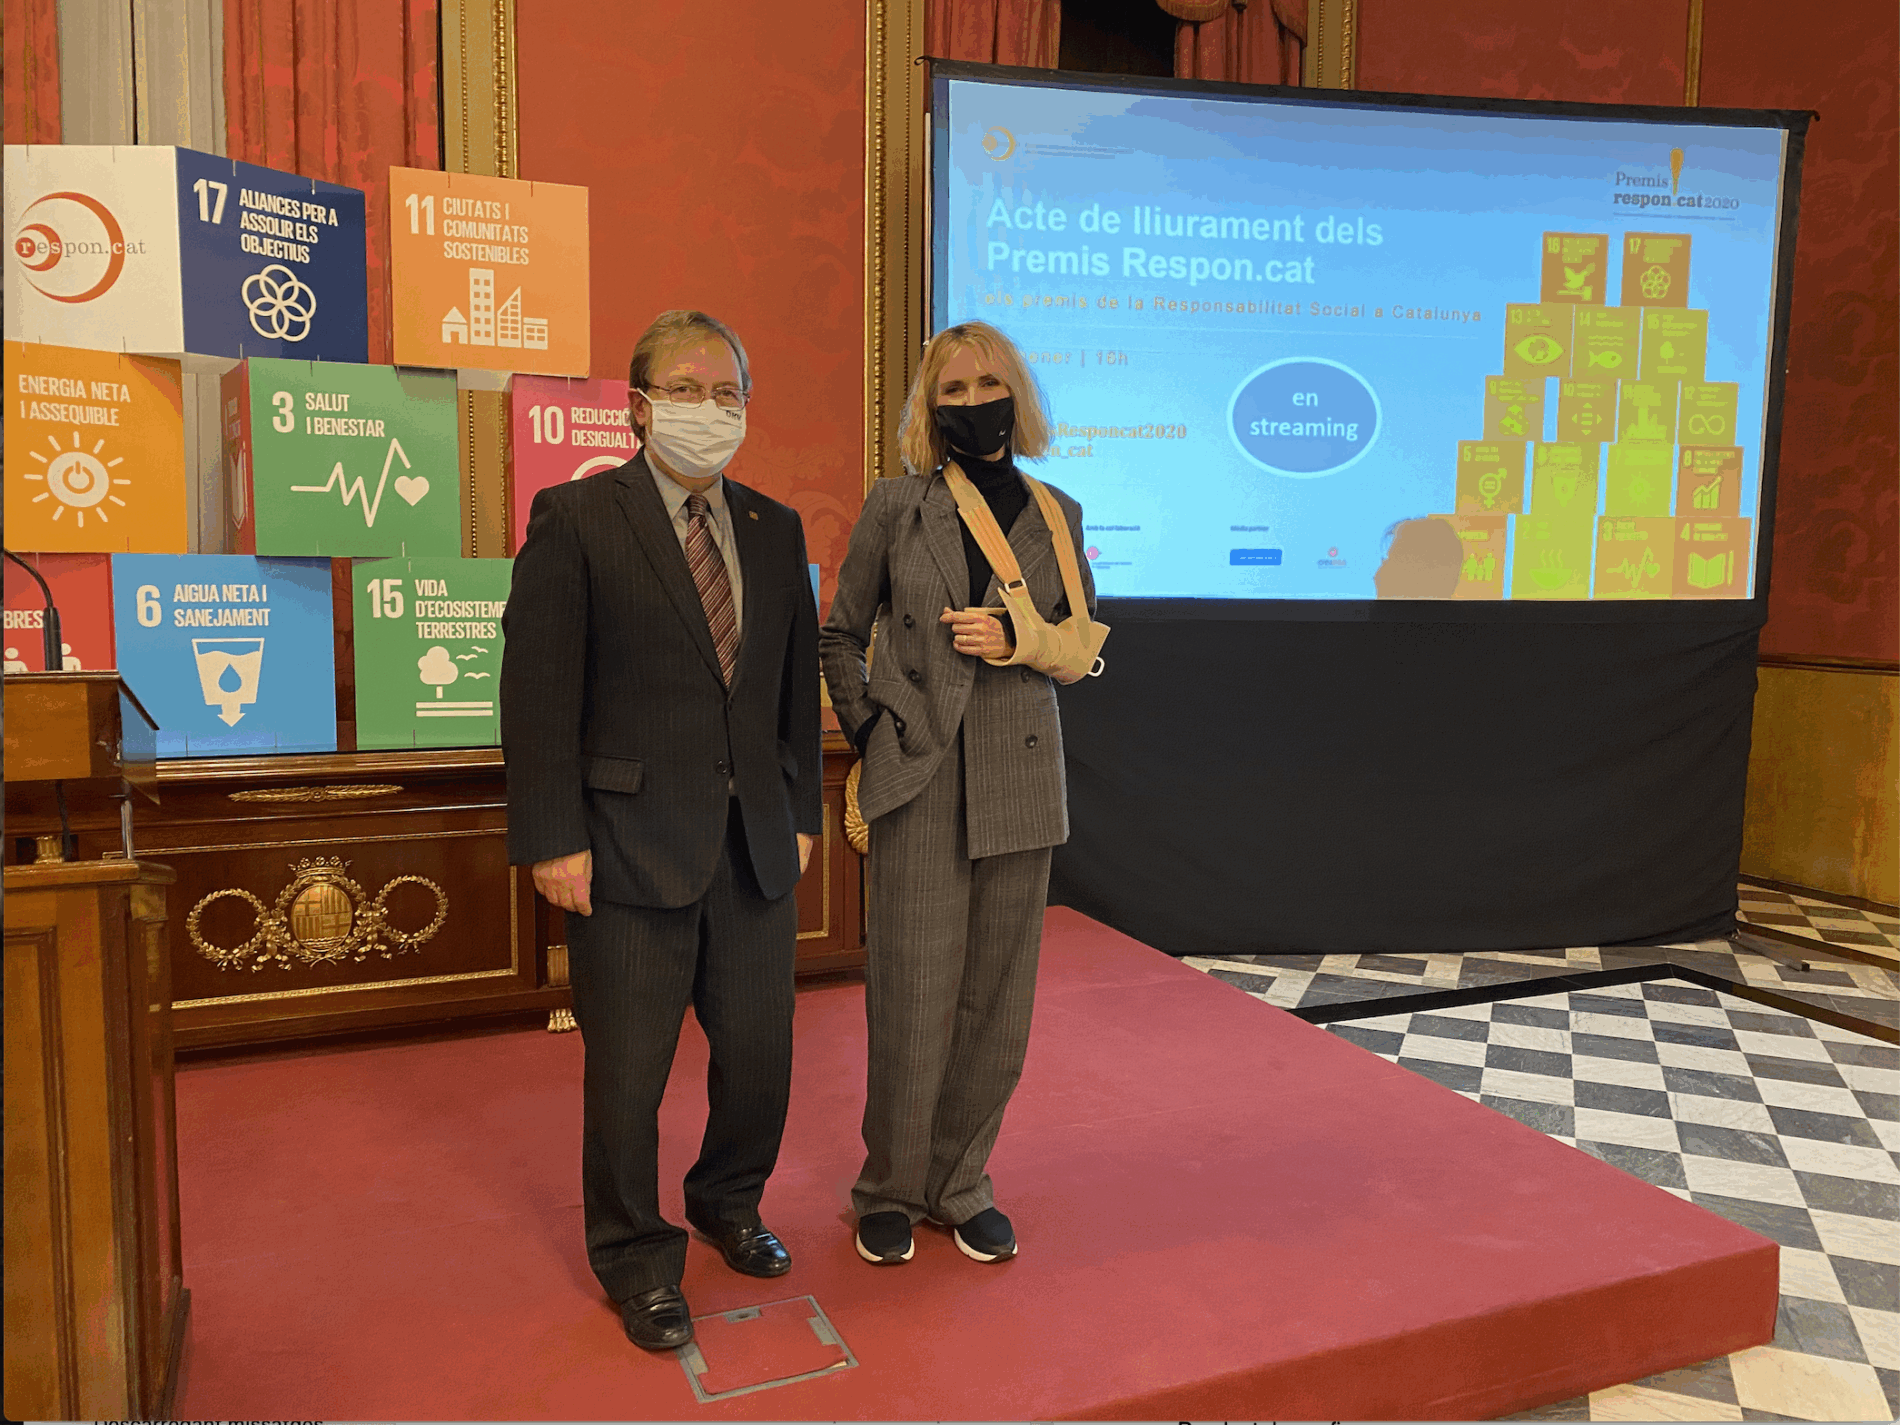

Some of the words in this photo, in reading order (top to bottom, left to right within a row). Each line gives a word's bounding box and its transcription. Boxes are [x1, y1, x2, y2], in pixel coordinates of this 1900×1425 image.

[1615, 171, 1669, 188] Premis
[192, 178, 228, 225] 17
[239, 188, 300, 219] ALIANCES
[302, 205, 325, 224] PER
[327, 208, 339, 227] A
[405, 193, 435, 236] 11
[443, 197, 501, 220] CIUTATS
[505, 203, 510, 220] I
[240, 215, 296, 240] ASSOLIR
[296, 223, 319, 244] ELS
[443, 219, 529, 244] COMUNITATS
[986, 198, 1067, 232] Acte
[1079, 203, 1121, 235] de
[1133, 206, 1305, 243] lliurament
[1316, 216, 1384, 247] dels
[19, 237, 147, 258] respon.cat
[240, 233, 311, 264] OBJECTIUS
[443, 241, 530, 266] SOSTENIBLES
[987, 241, 1110, 278] Premis
[1122, 247, 1316, 287] Respon.cat
[1022, 292, 1088, 309] premis
[1096, 294, 1119, 310] de
[1128, 295, 1144, 311] la
[1153, 296, 1301, 316] Responsabilitat
[1310, 302, 1366, 318] Social
[1374, 307, 1384, 318] a
[1392, 304, 1482, 324] Catalunya
[19, 375, 87, 399] ENERGIA
[91, 382, 131, 402] NETA
[1292, 392, 1319, 407] en
[19, 401, 25, 419] I
[30, 402, 120, 427] ASSEQUIBLE
[272, 391, 295, 433] 3
[305, 393, 349, 413] SALUT
[306, 417, 312, 434] I
[313, 418, 385, 438] BENESTAR
[528, 404, 565, 446] 10
[1250, 417, 1359, 441] streaming
[173, 584, 220, 603] AIGUA
[222, 584, 260, 602] NETA
[262, 584, 267, 602] I
[367, 579, 404, 619] 15
[415, 579, 448, 596] VIDA
[136, 584, 162, 628] 6
[173, 608, 271, 627] SANEJAMENT
[416, 621, 497, 639] TERRESTRES
